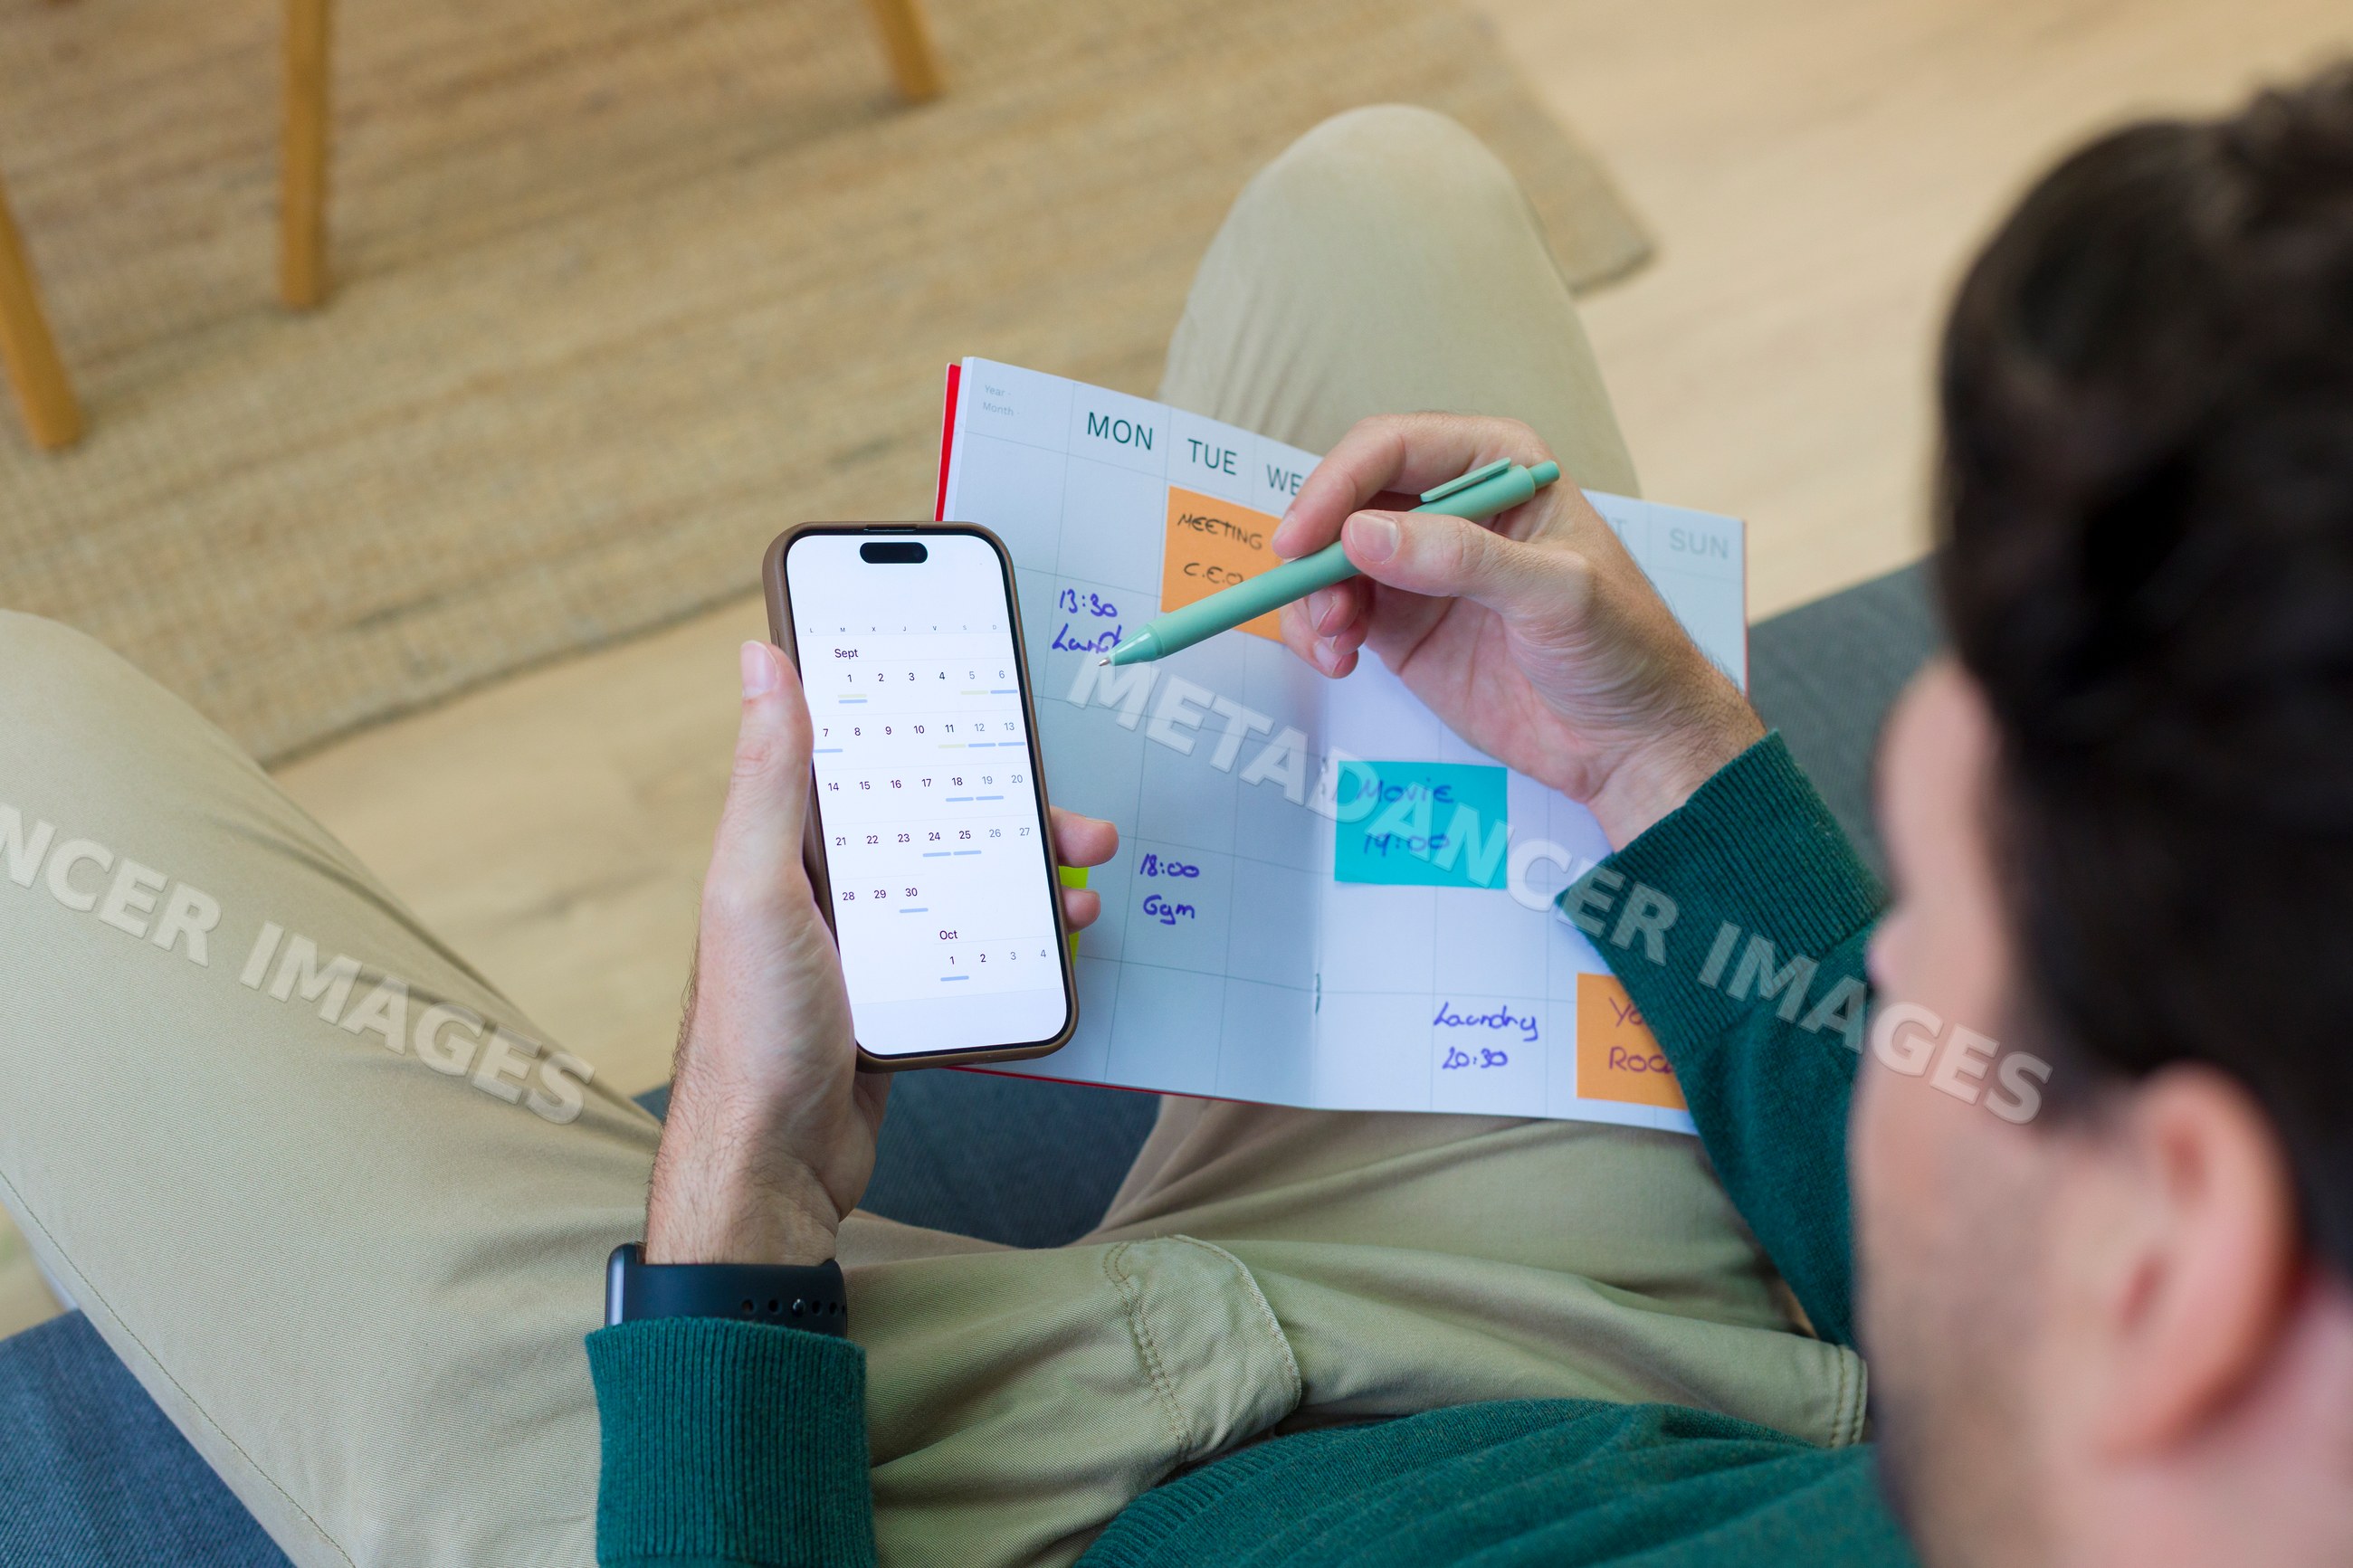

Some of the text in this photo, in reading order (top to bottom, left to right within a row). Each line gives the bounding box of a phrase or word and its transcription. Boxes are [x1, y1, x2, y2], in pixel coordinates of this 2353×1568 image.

[985, 384, 1005, 396] Year
[983, 401, 1015, 416] Month
[1087, 411, 1154, 451] MON
[1187, 438, 1238, 476] TUE
[1266, 463, 1303, 496] WE
[1668, 527, 1729, 560] SUN
[1176, 512, 1263, 551] MEETING
[1059, 587, 1119, 618] 13:30
[834, 648, 859, 660] Sept
[847, 670, 1005, 683] 1 2 3 4 5 6
[823, 721, 1015, 737] 7 8 9 10 11 12 13
[827, 774, 1024, 792] 14 15 16 17 18 19 20
[835, 827, 1031, 846] 21 22 23 24 25 26 27
[1139, 852, 1200, 879] 18:00
[842, 887, 919, 901] 28 29 30
[1143, 893, 1196, 926] Gym
[938, 929, 958, 941] Oct
[949, 949, 1047, 965] 1 2 3 4
[1442, 1046, 1509, 1069] 20:30
